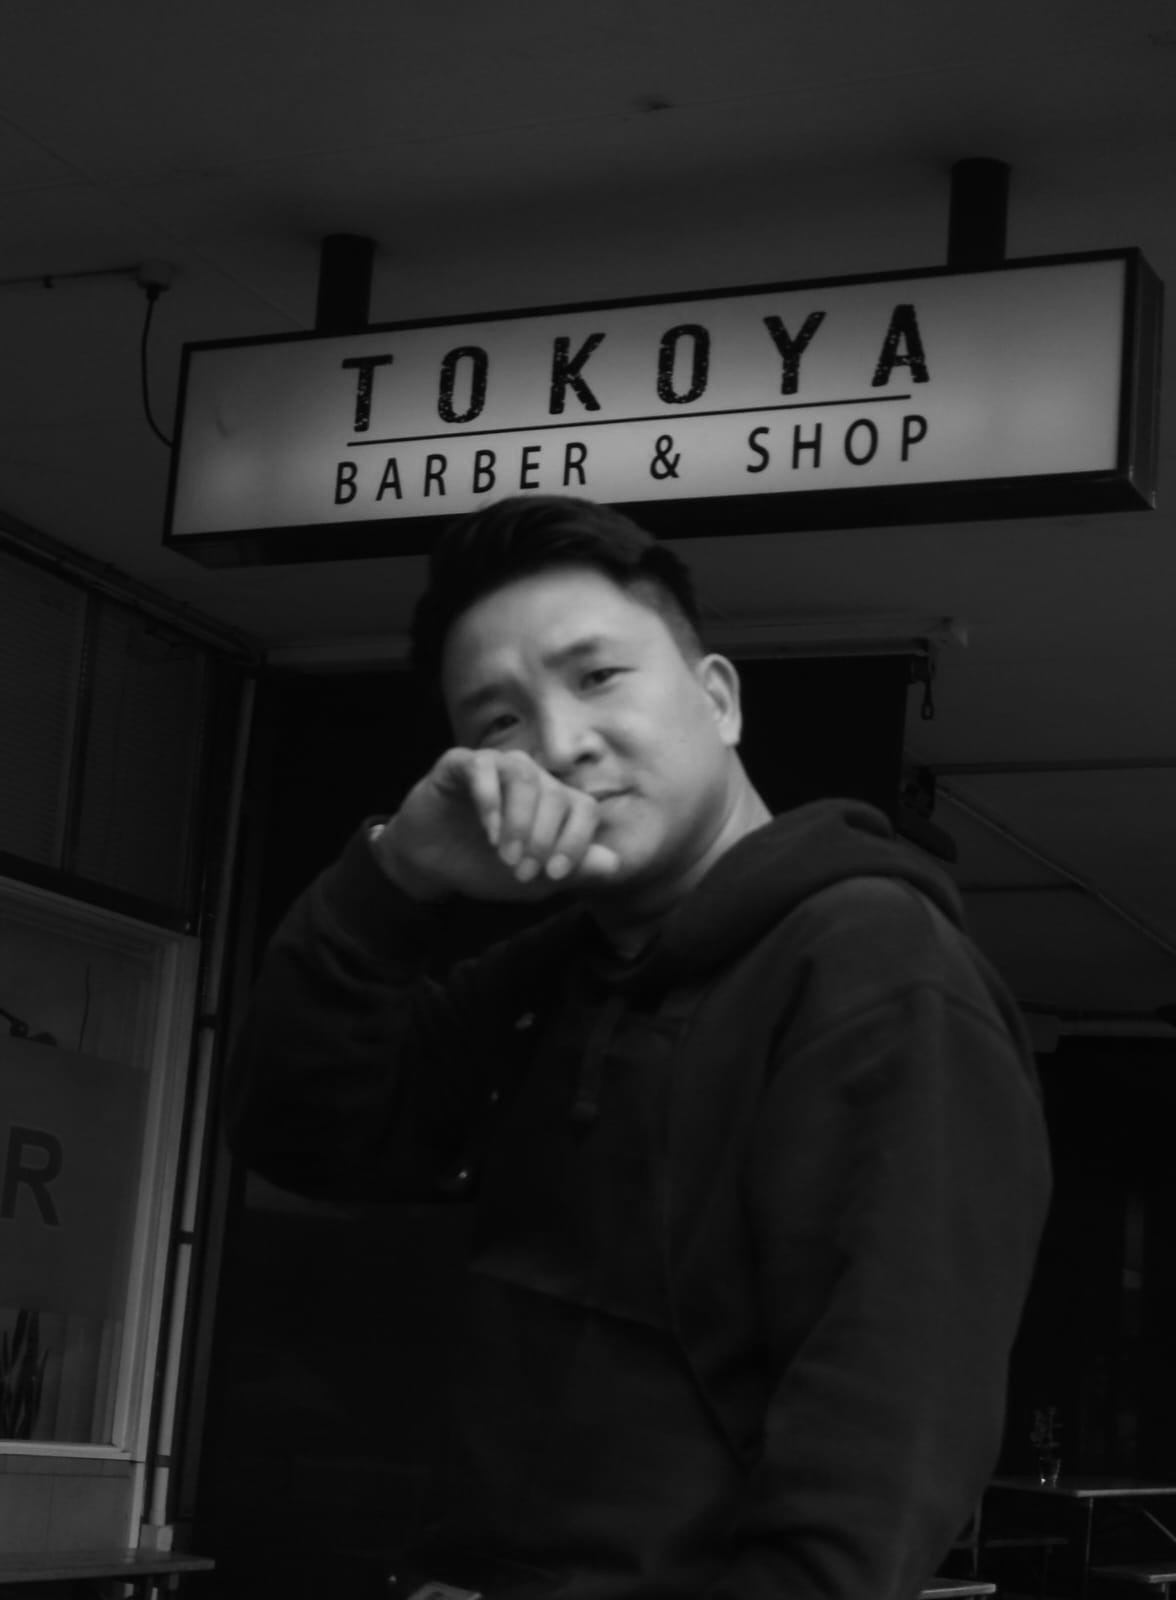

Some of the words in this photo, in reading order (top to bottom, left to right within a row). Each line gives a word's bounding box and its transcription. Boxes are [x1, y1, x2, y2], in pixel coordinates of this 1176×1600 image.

[341, 304, 930, 432] TOKOYA
[334, 442, 588, 505] BARBER
[650, 434, 681, 480] &
[746, 414, 928, 473] SHOP
